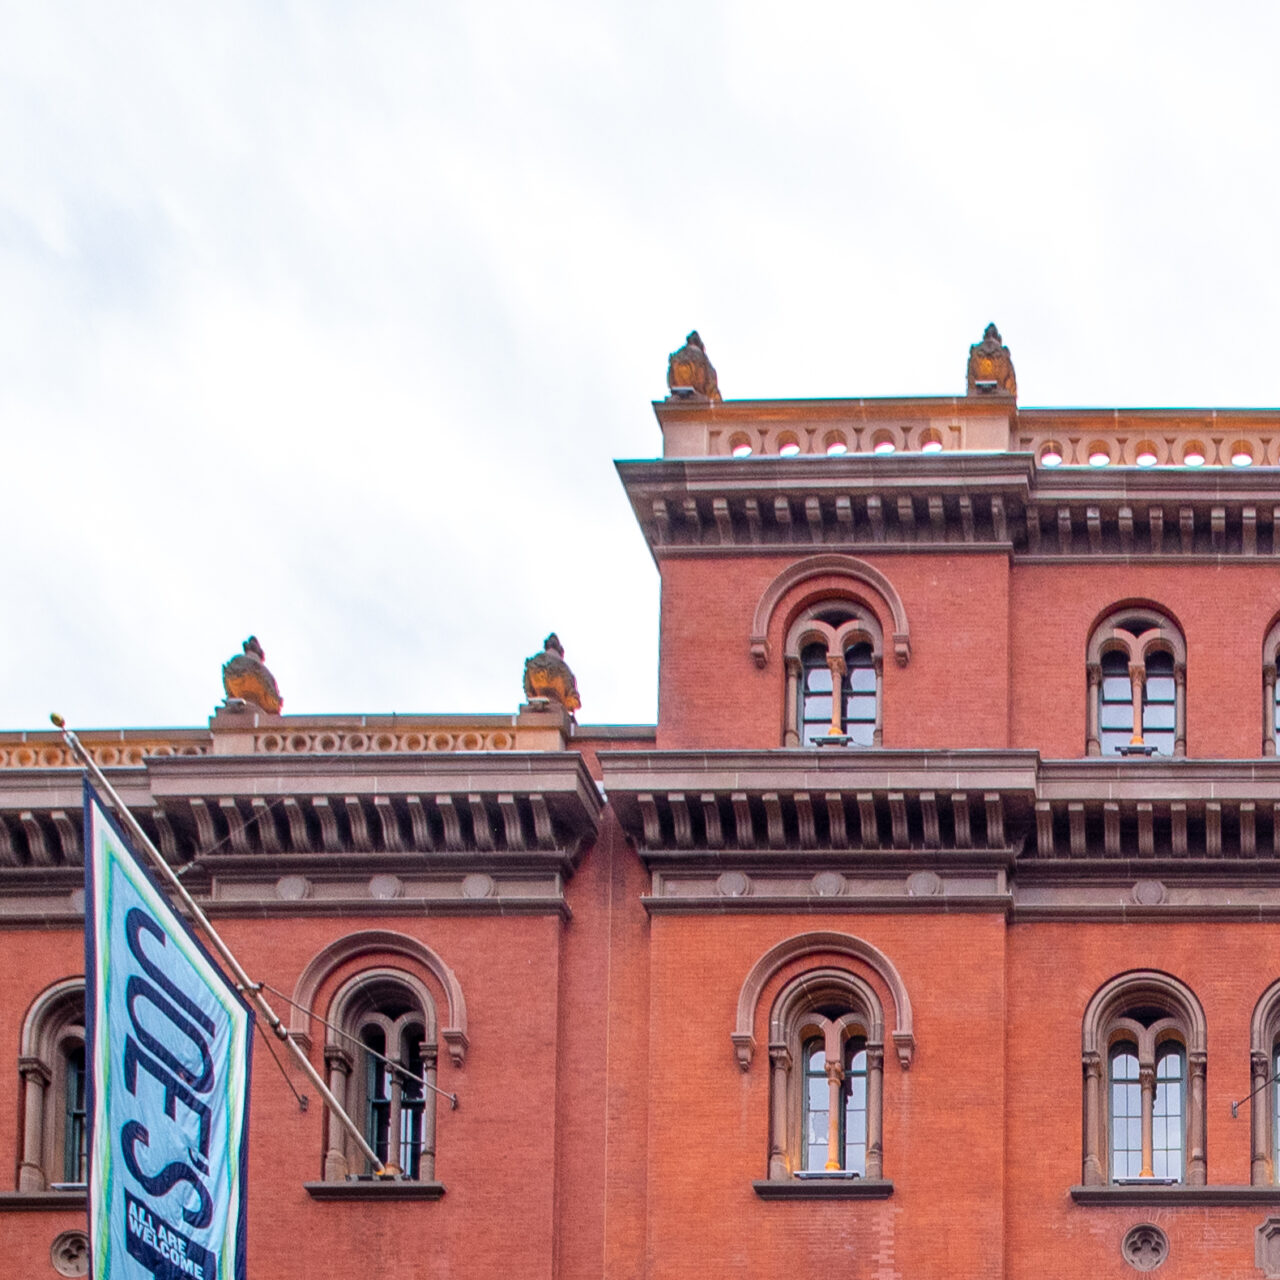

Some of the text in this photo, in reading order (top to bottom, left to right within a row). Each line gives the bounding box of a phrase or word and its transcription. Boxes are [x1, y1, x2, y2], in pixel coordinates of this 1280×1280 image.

[121, 907, 215, 1229] JOE'S
[128, 1200, 187, 1257] ALL ARE
